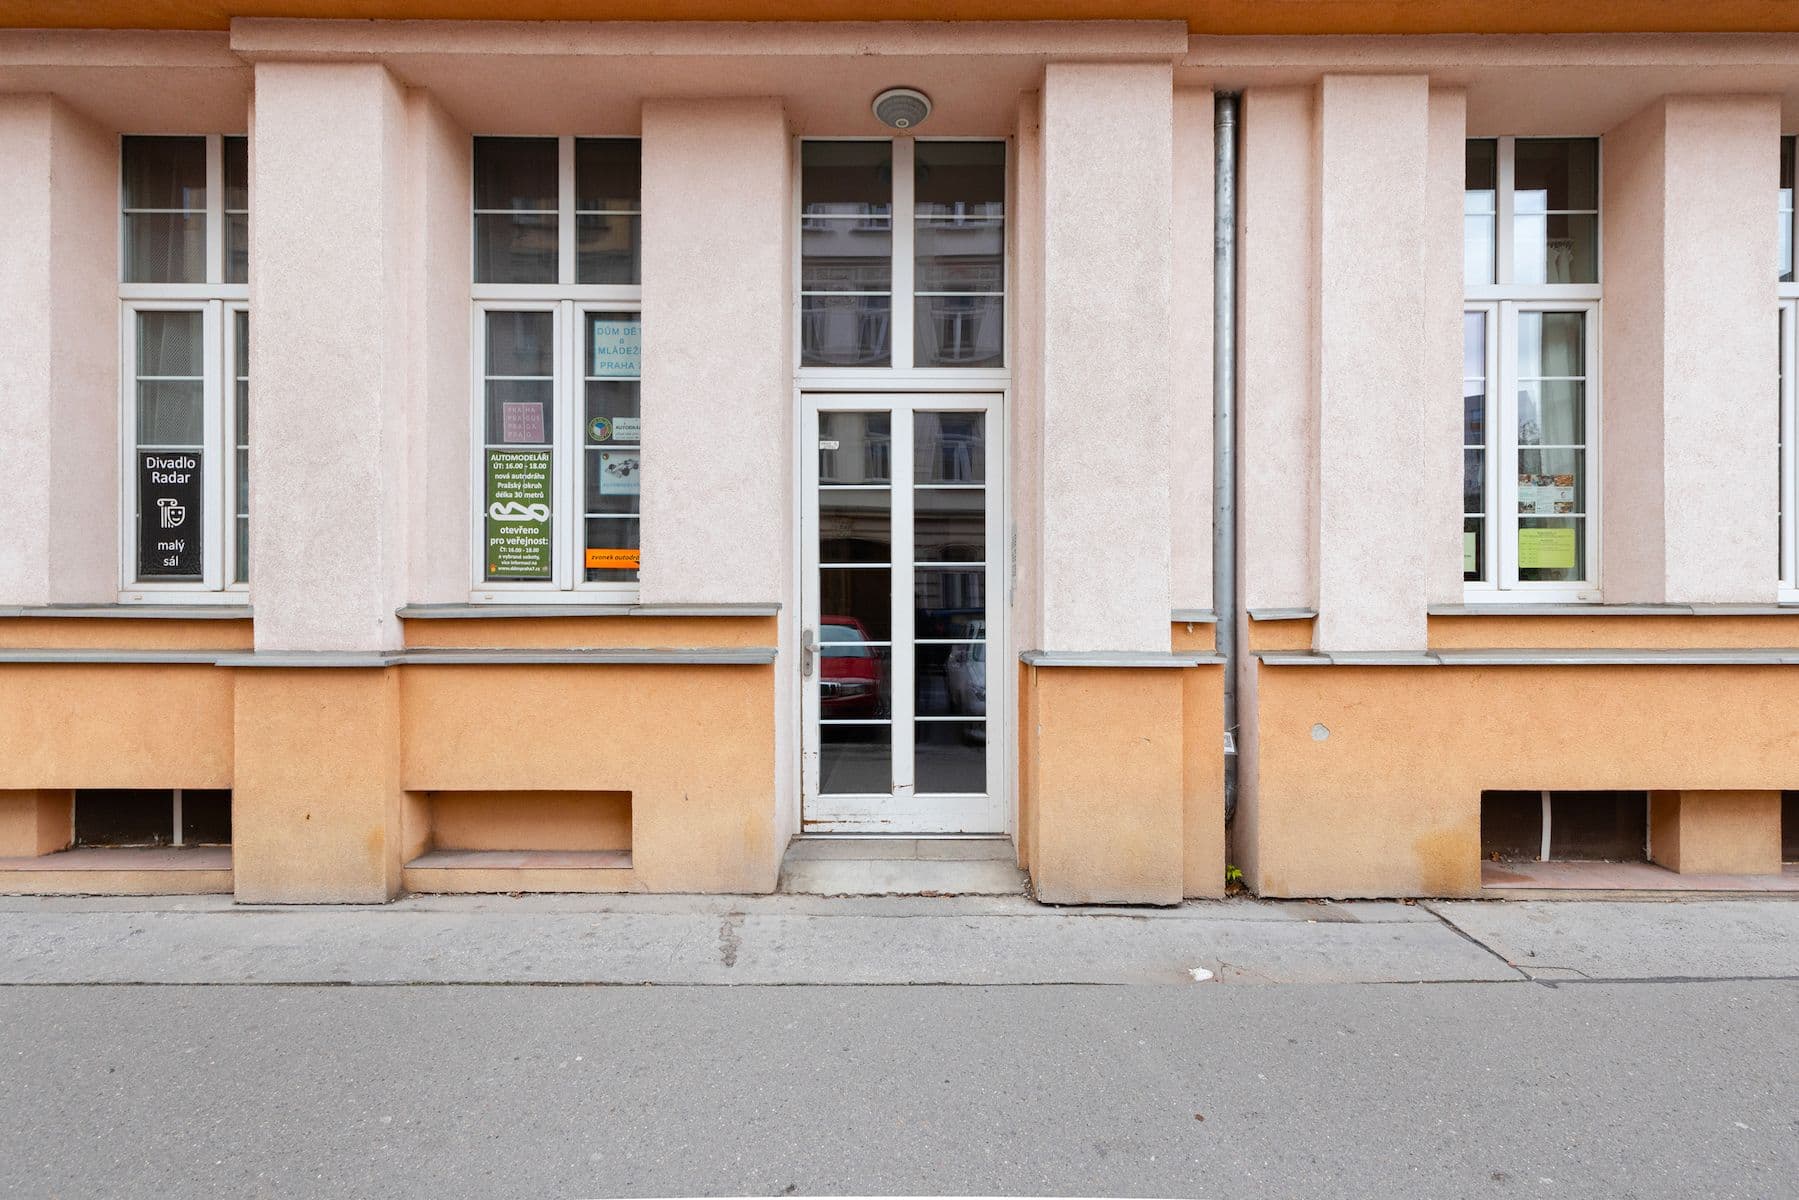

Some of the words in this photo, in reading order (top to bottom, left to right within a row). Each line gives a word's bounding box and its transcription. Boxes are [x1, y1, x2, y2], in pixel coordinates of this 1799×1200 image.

[624, 326, 641, 336] DĚ
[598, 345, 641, 355] MLÁDEŽ
[600, 361, 635, 369] PRAHA
[491, 453, 550, 461] AUTOMODELÁŘI
[146, 457, 196, 469] Divadlo
[493, 461, 505, 469] ÚT:
[152, 471, 191, 483] Radar
[500, 525, 540, 534] otevřeno
[157, 539, 185, 552] malý
[490, 537, 505, 546] pro
[506, 536, 549, 546] veřejnost:
[163, 555, 179, 567] sál
